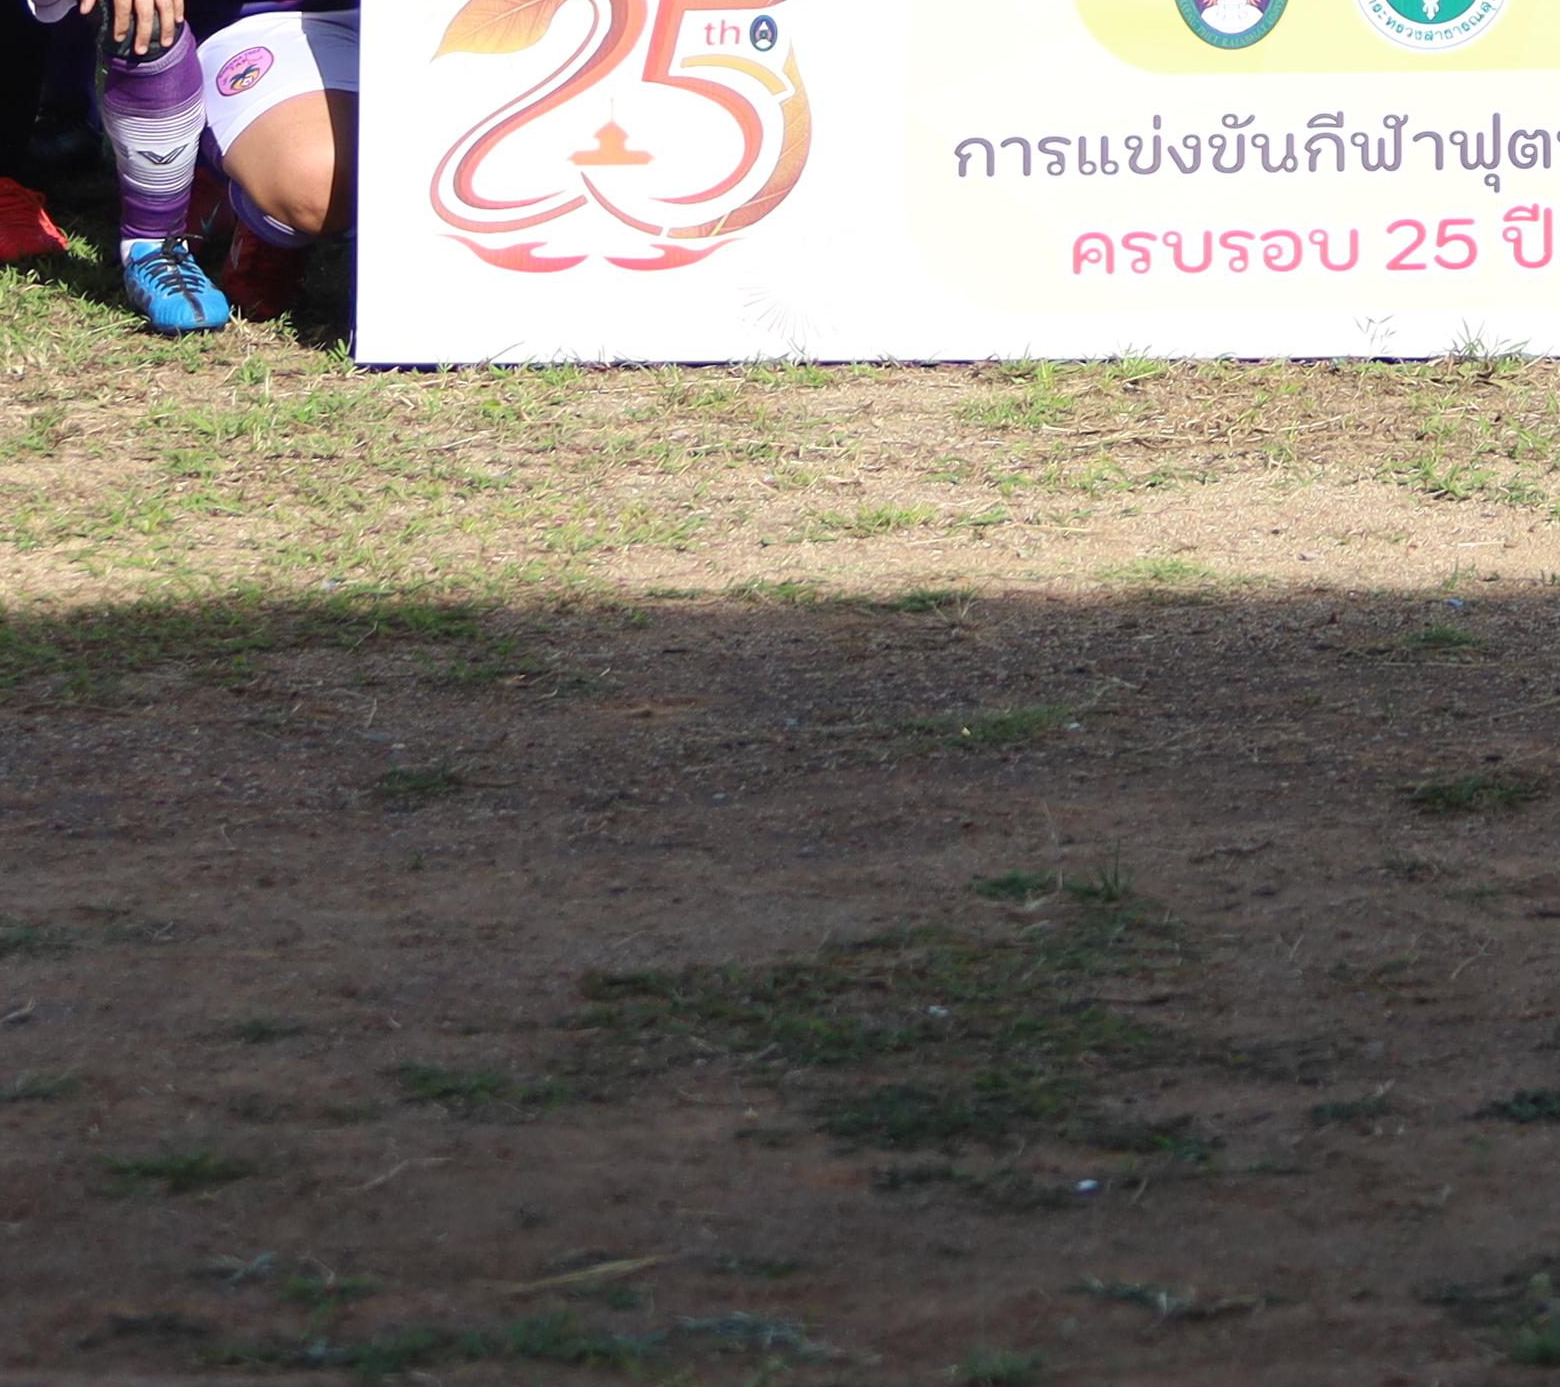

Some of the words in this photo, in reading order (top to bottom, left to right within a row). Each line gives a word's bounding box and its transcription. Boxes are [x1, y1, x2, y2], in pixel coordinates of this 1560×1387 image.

[704, 19, 740, 46] th
[1071, 227, 1360, 275] ครบรอบ
[1385, 218, 1479, 271] 25
[1501, 202, 1554, 270] ปี
